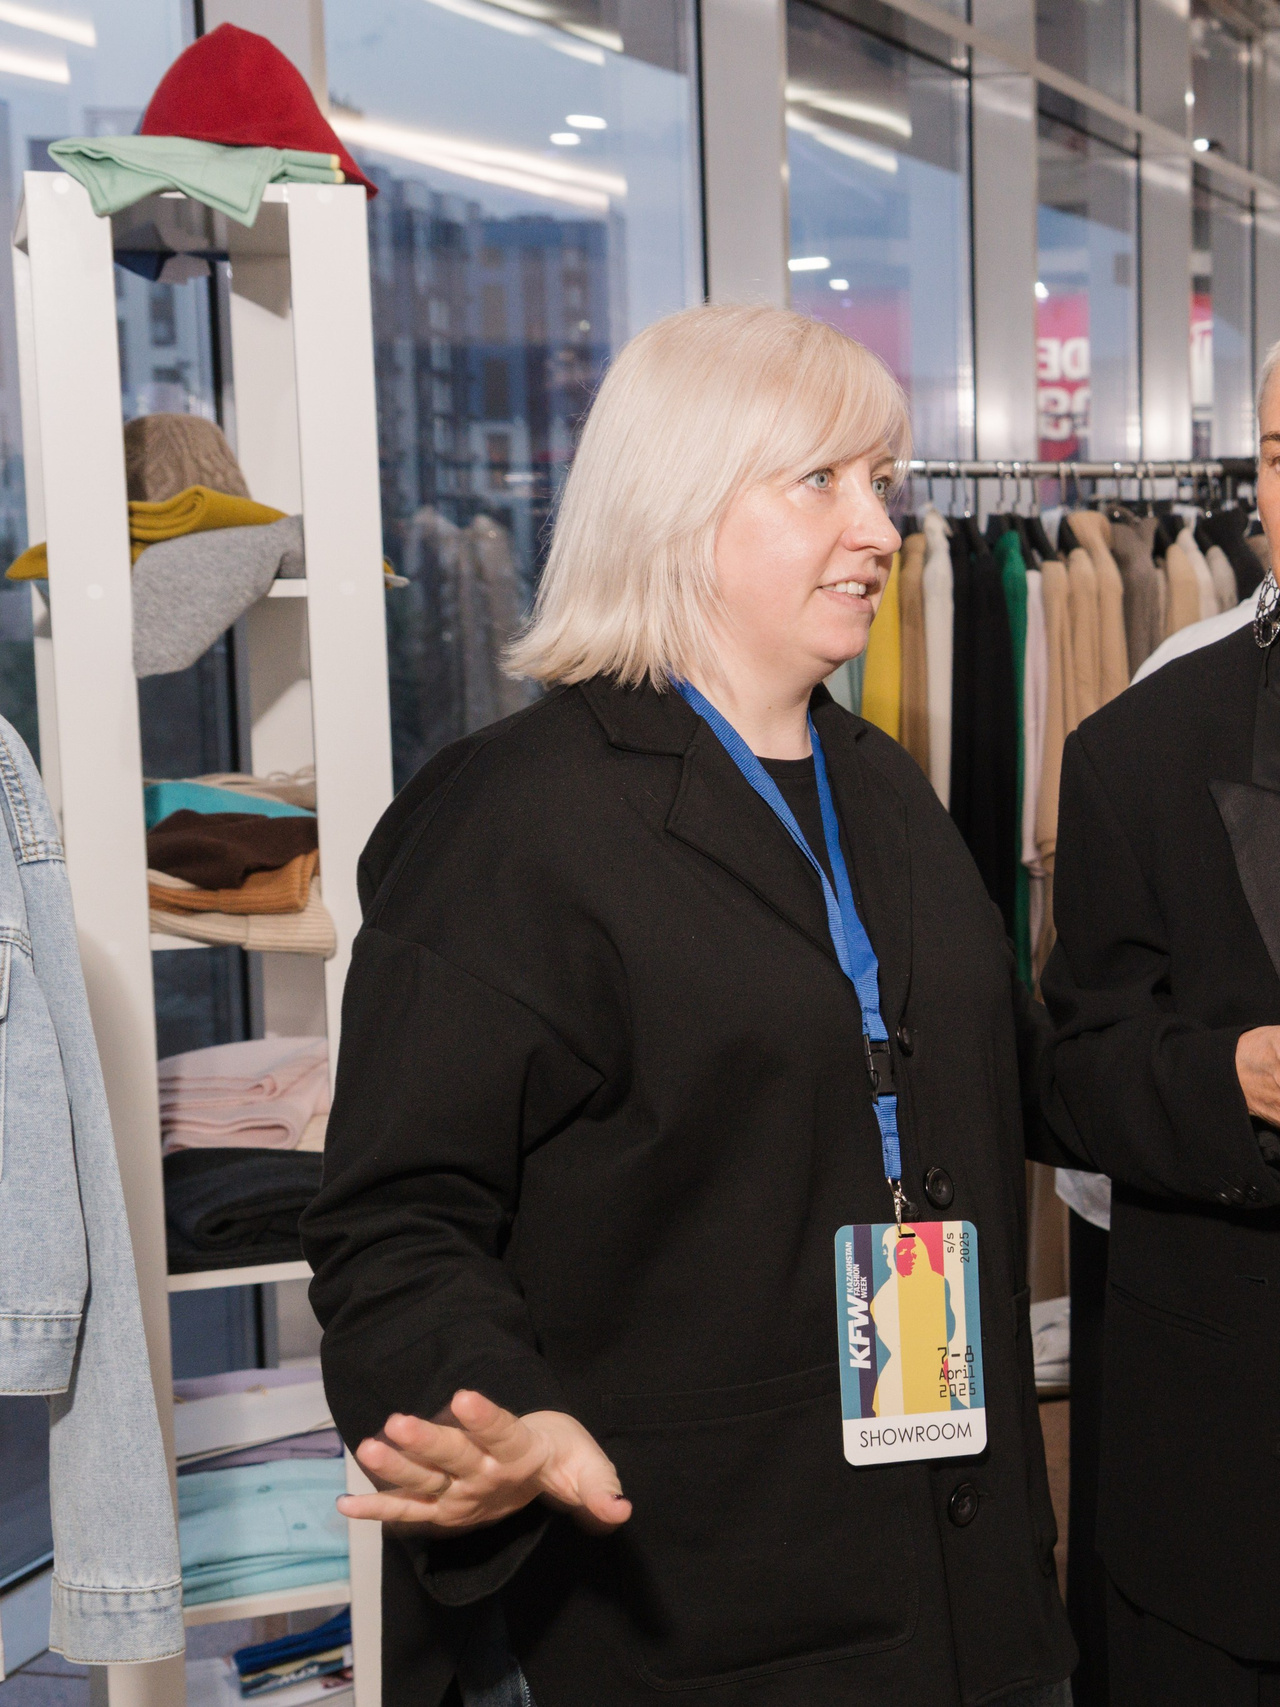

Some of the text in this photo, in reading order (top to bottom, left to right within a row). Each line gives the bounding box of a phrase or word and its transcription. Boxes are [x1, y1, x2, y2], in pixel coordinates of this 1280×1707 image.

[959, 1232, 970, 1264] 2025
[845, 1241, 854, 1294] KAZAKHSTAN
[853, 1263, 861, 1297] FASHION
[860, 1276, 868, 1299] WEEK
[846, 1293, 872, 1370] KFW
[939, 1365, 976, 1381] April
[939, 1382, 976, 1398] 2025
[860, 1422, 972, 1448] SHOWROOM
